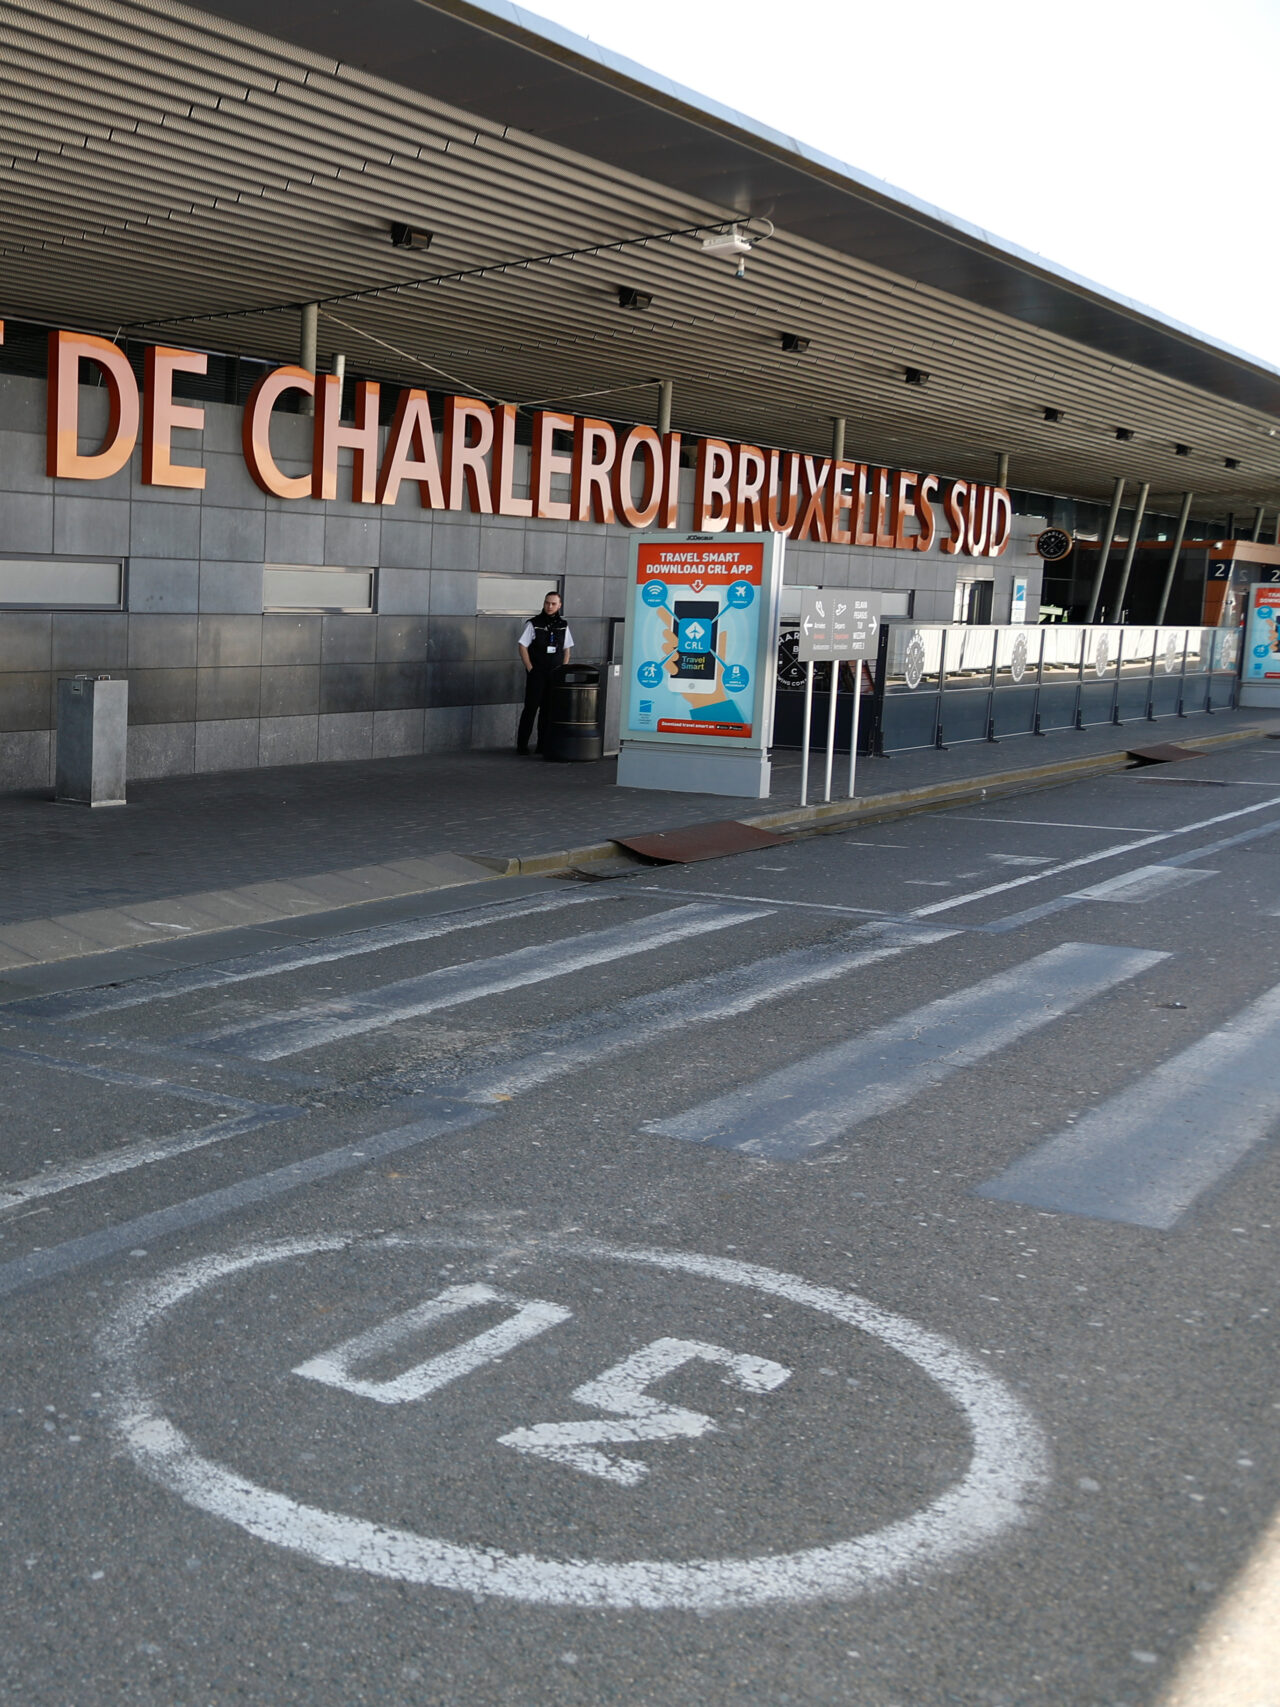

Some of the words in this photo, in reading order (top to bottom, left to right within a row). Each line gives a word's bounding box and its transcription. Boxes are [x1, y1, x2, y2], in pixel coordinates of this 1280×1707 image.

[47, 330, 207, 489] DE
[242, 366, 680, 529] CHARLEROI
[695, 438, 938, 552] BRUXELLES
[941, 479, 1011, 557] SUD
[660, 552, 700, 562] TRAVEL
[702, 552, 740, 562] SMART
[646, 564, 705, 574] DOWNLOAD
[708, 564, 729, 574] CRL
[730, 564, 753, 575] APP
[1215, 563, 1225, 577] 2
[684, 641, 703, 650] CRL
[681, 655, 705, 663] Travel
[681, 662, 705, 670] Smart
